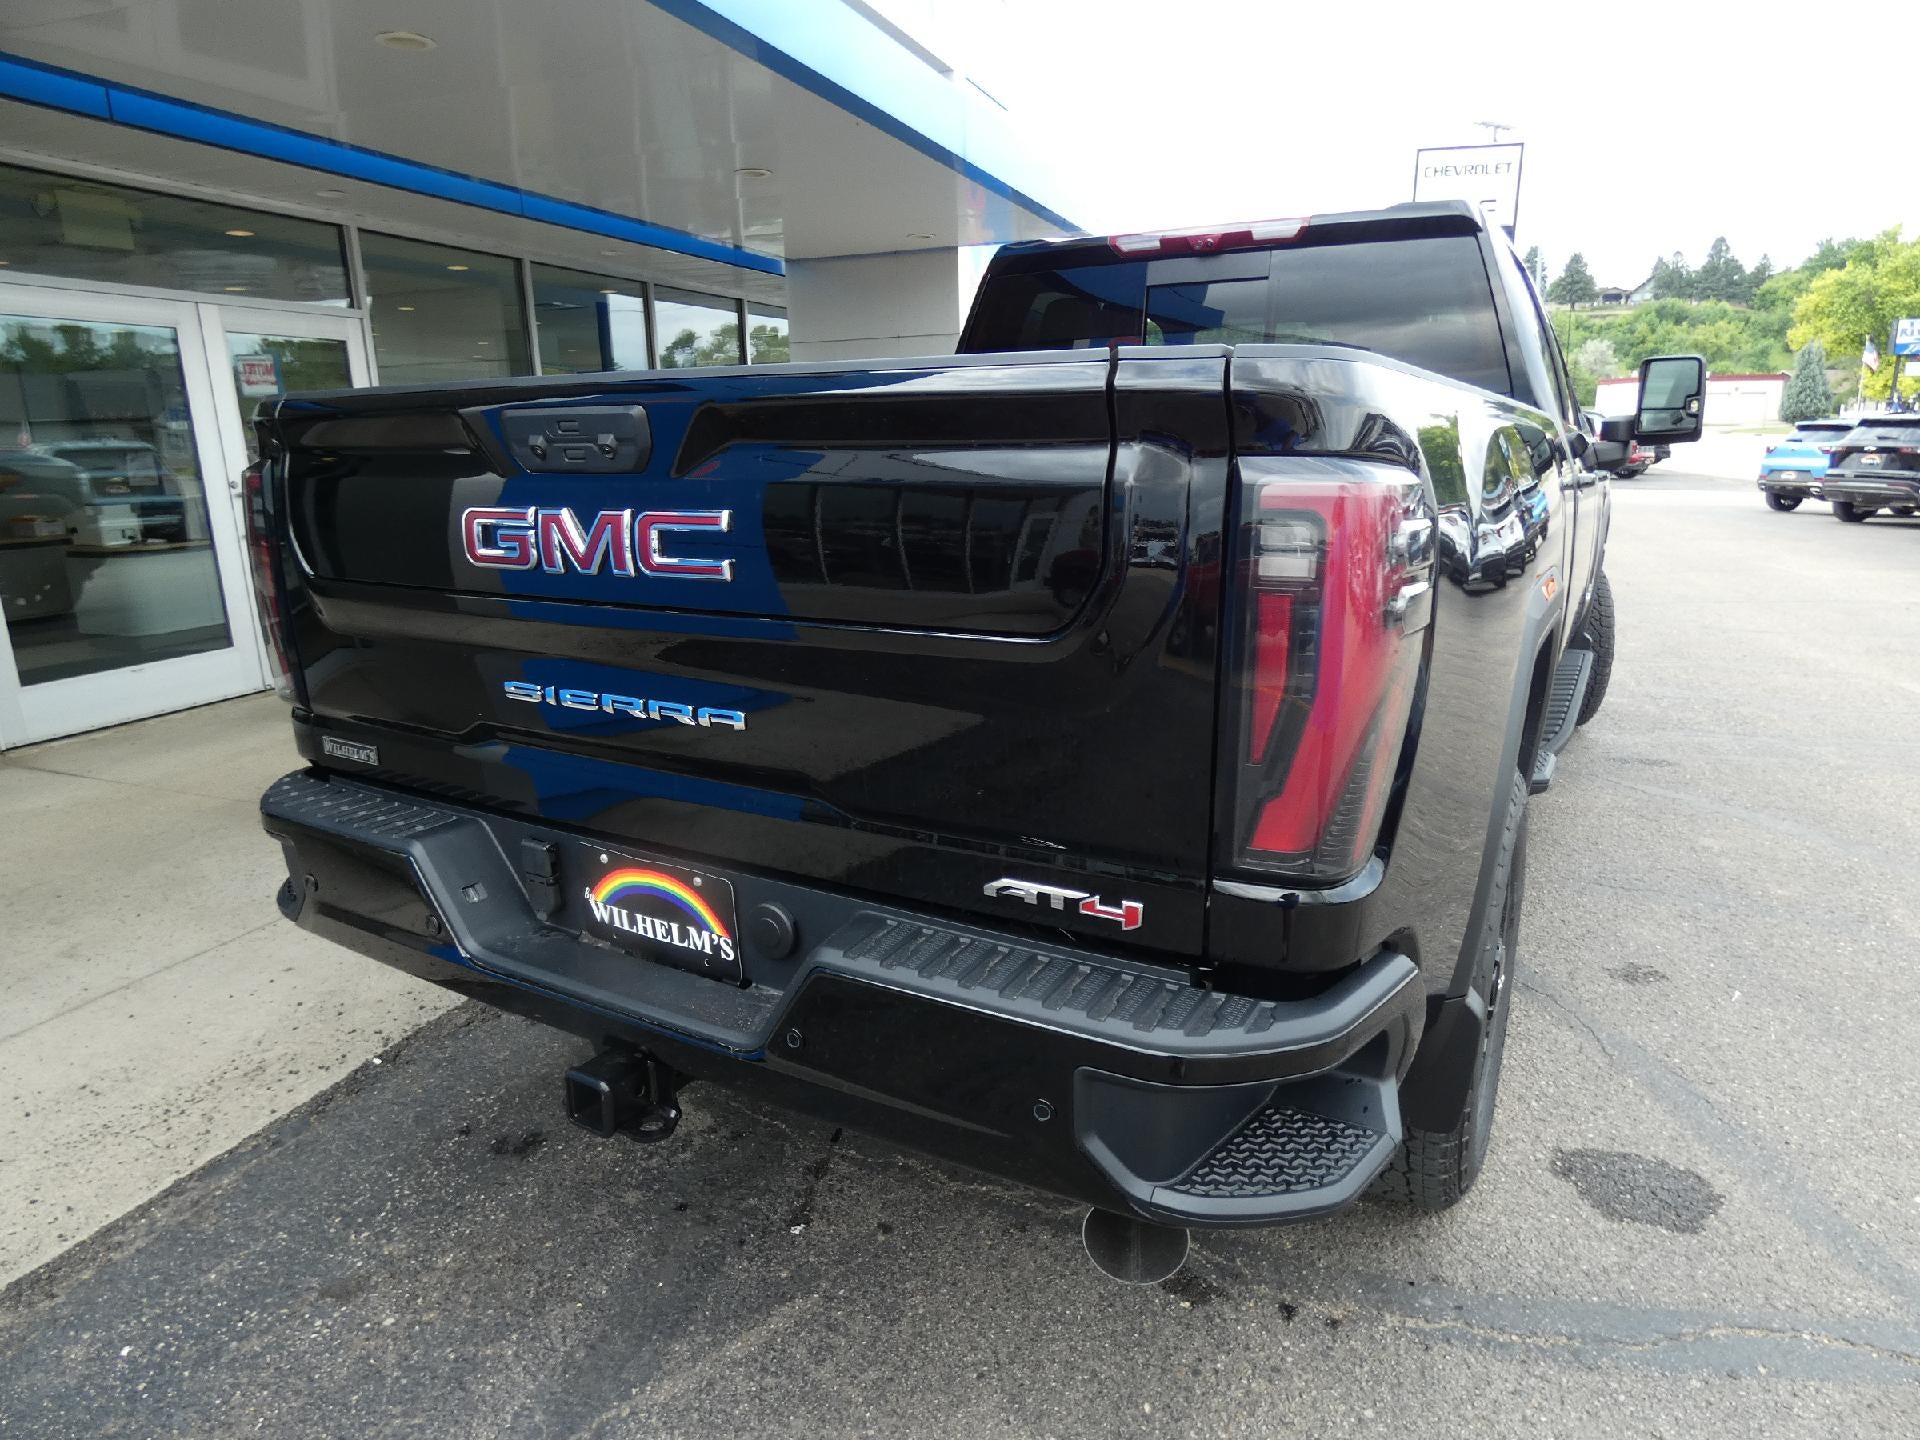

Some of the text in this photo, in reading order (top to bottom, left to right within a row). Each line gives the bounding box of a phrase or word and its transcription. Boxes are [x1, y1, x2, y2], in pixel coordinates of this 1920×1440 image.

[1424, 162, 1512, 178] CHEVROLET
[462, 506, 735, 582] GMC
[504, 681, 747, 731] SIERRA
[589, 900, 735, 961] WILHELM'S
[984, 878, 1143, 931] AT4
